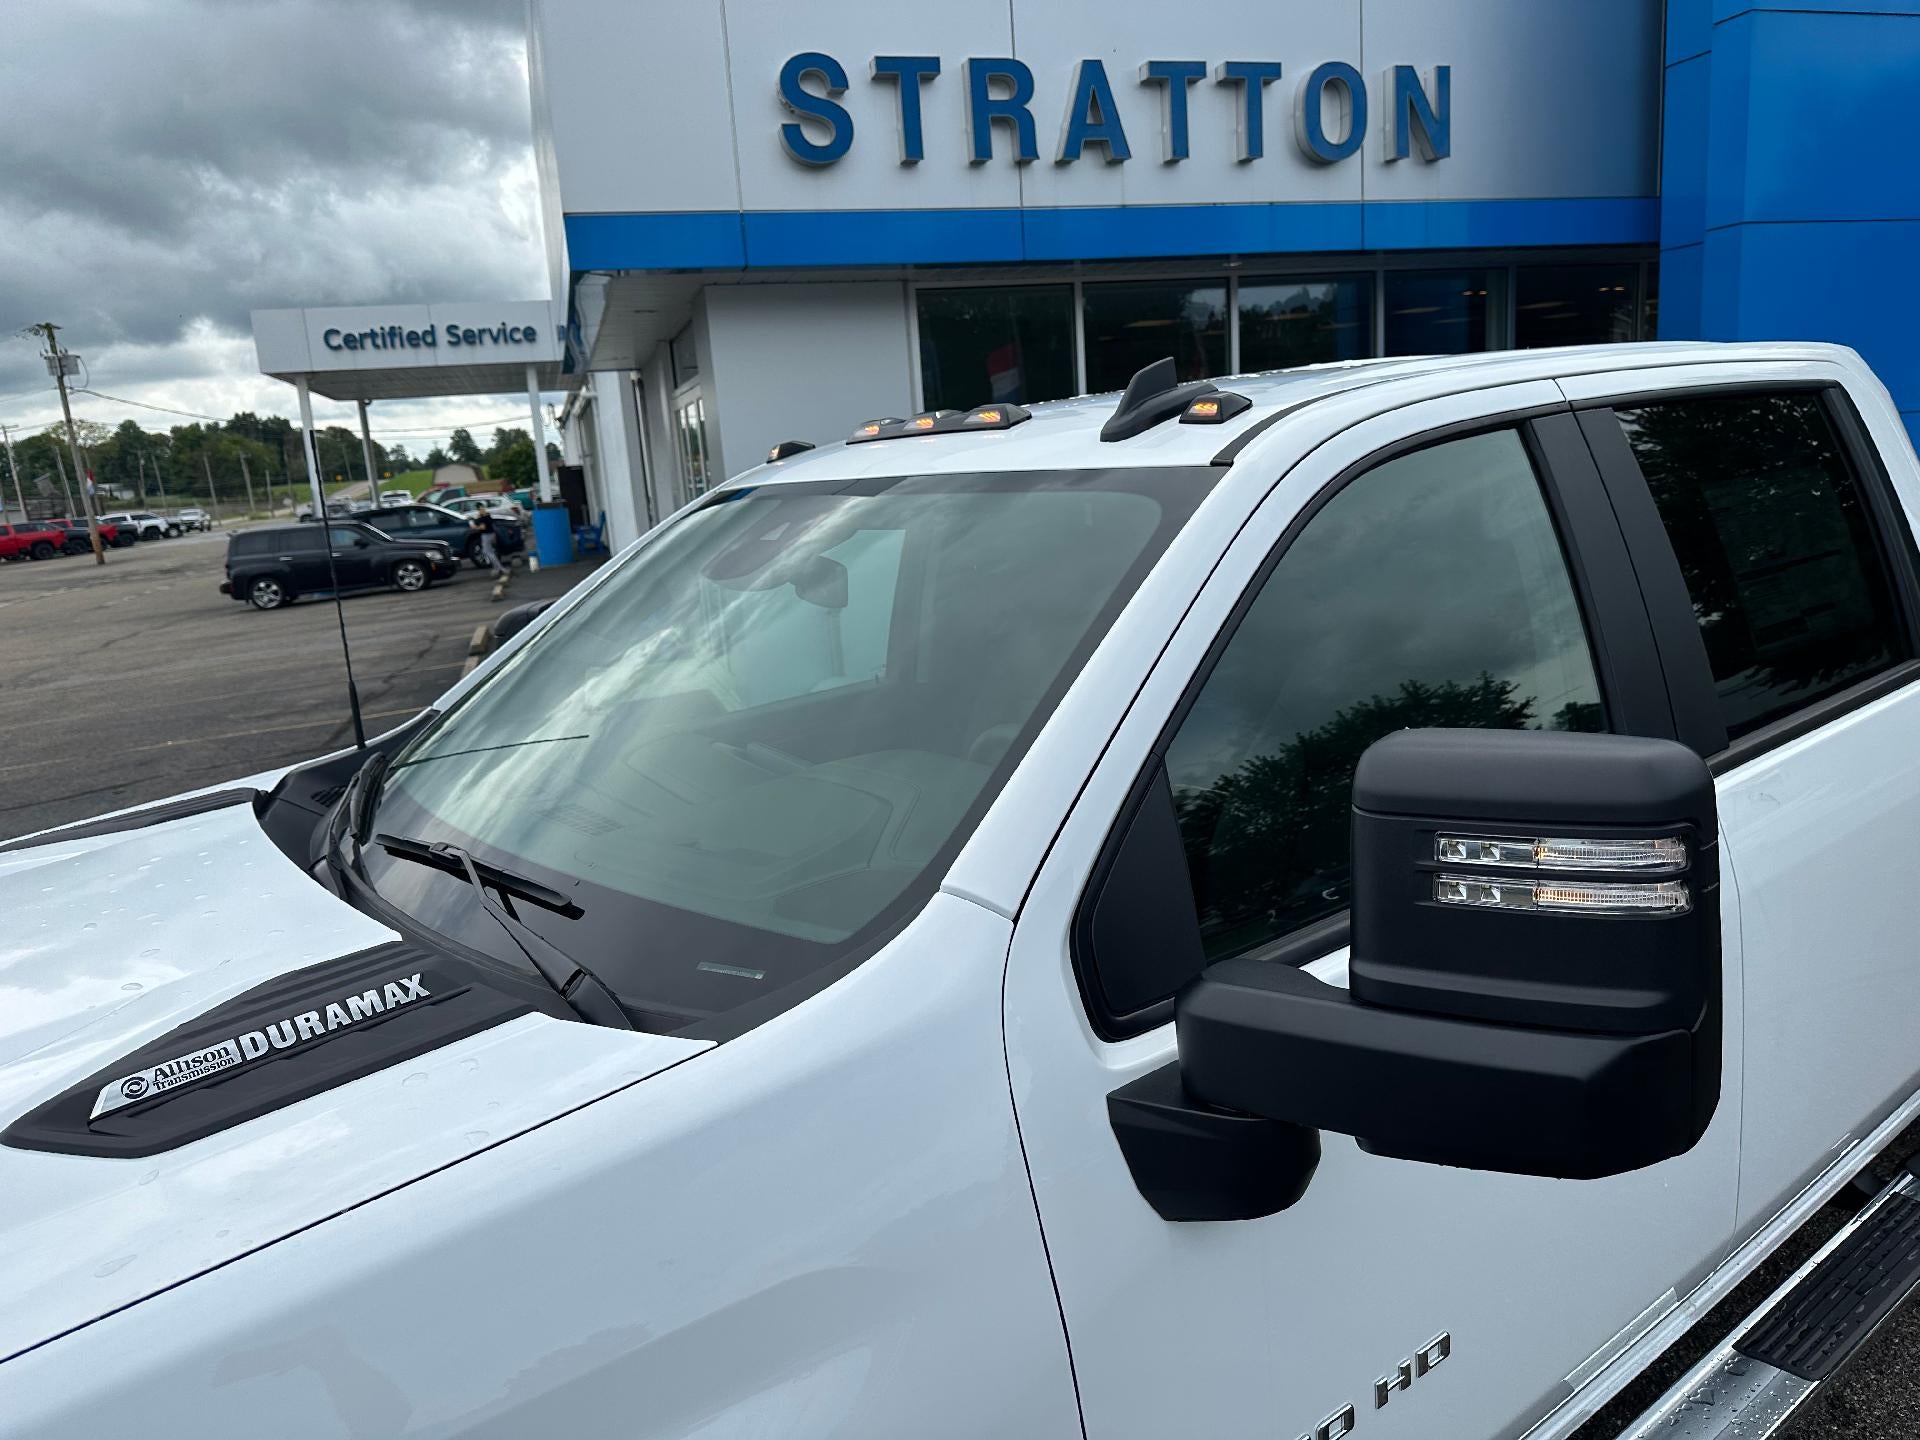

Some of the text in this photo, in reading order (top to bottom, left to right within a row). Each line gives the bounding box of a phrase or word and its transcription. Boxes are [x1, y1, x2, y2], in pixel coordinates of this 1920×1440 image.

[779, 52, 1452, 167] STRATTON
[323, 322, 538, 350] Certified Service
[241, 973, 431, 1061] DURAMAX
[152, 1056, 236, 1091] Transmission
[153, 1046, 232, 1082] Allison
[1374, 1330, 1450, 1409] HD
